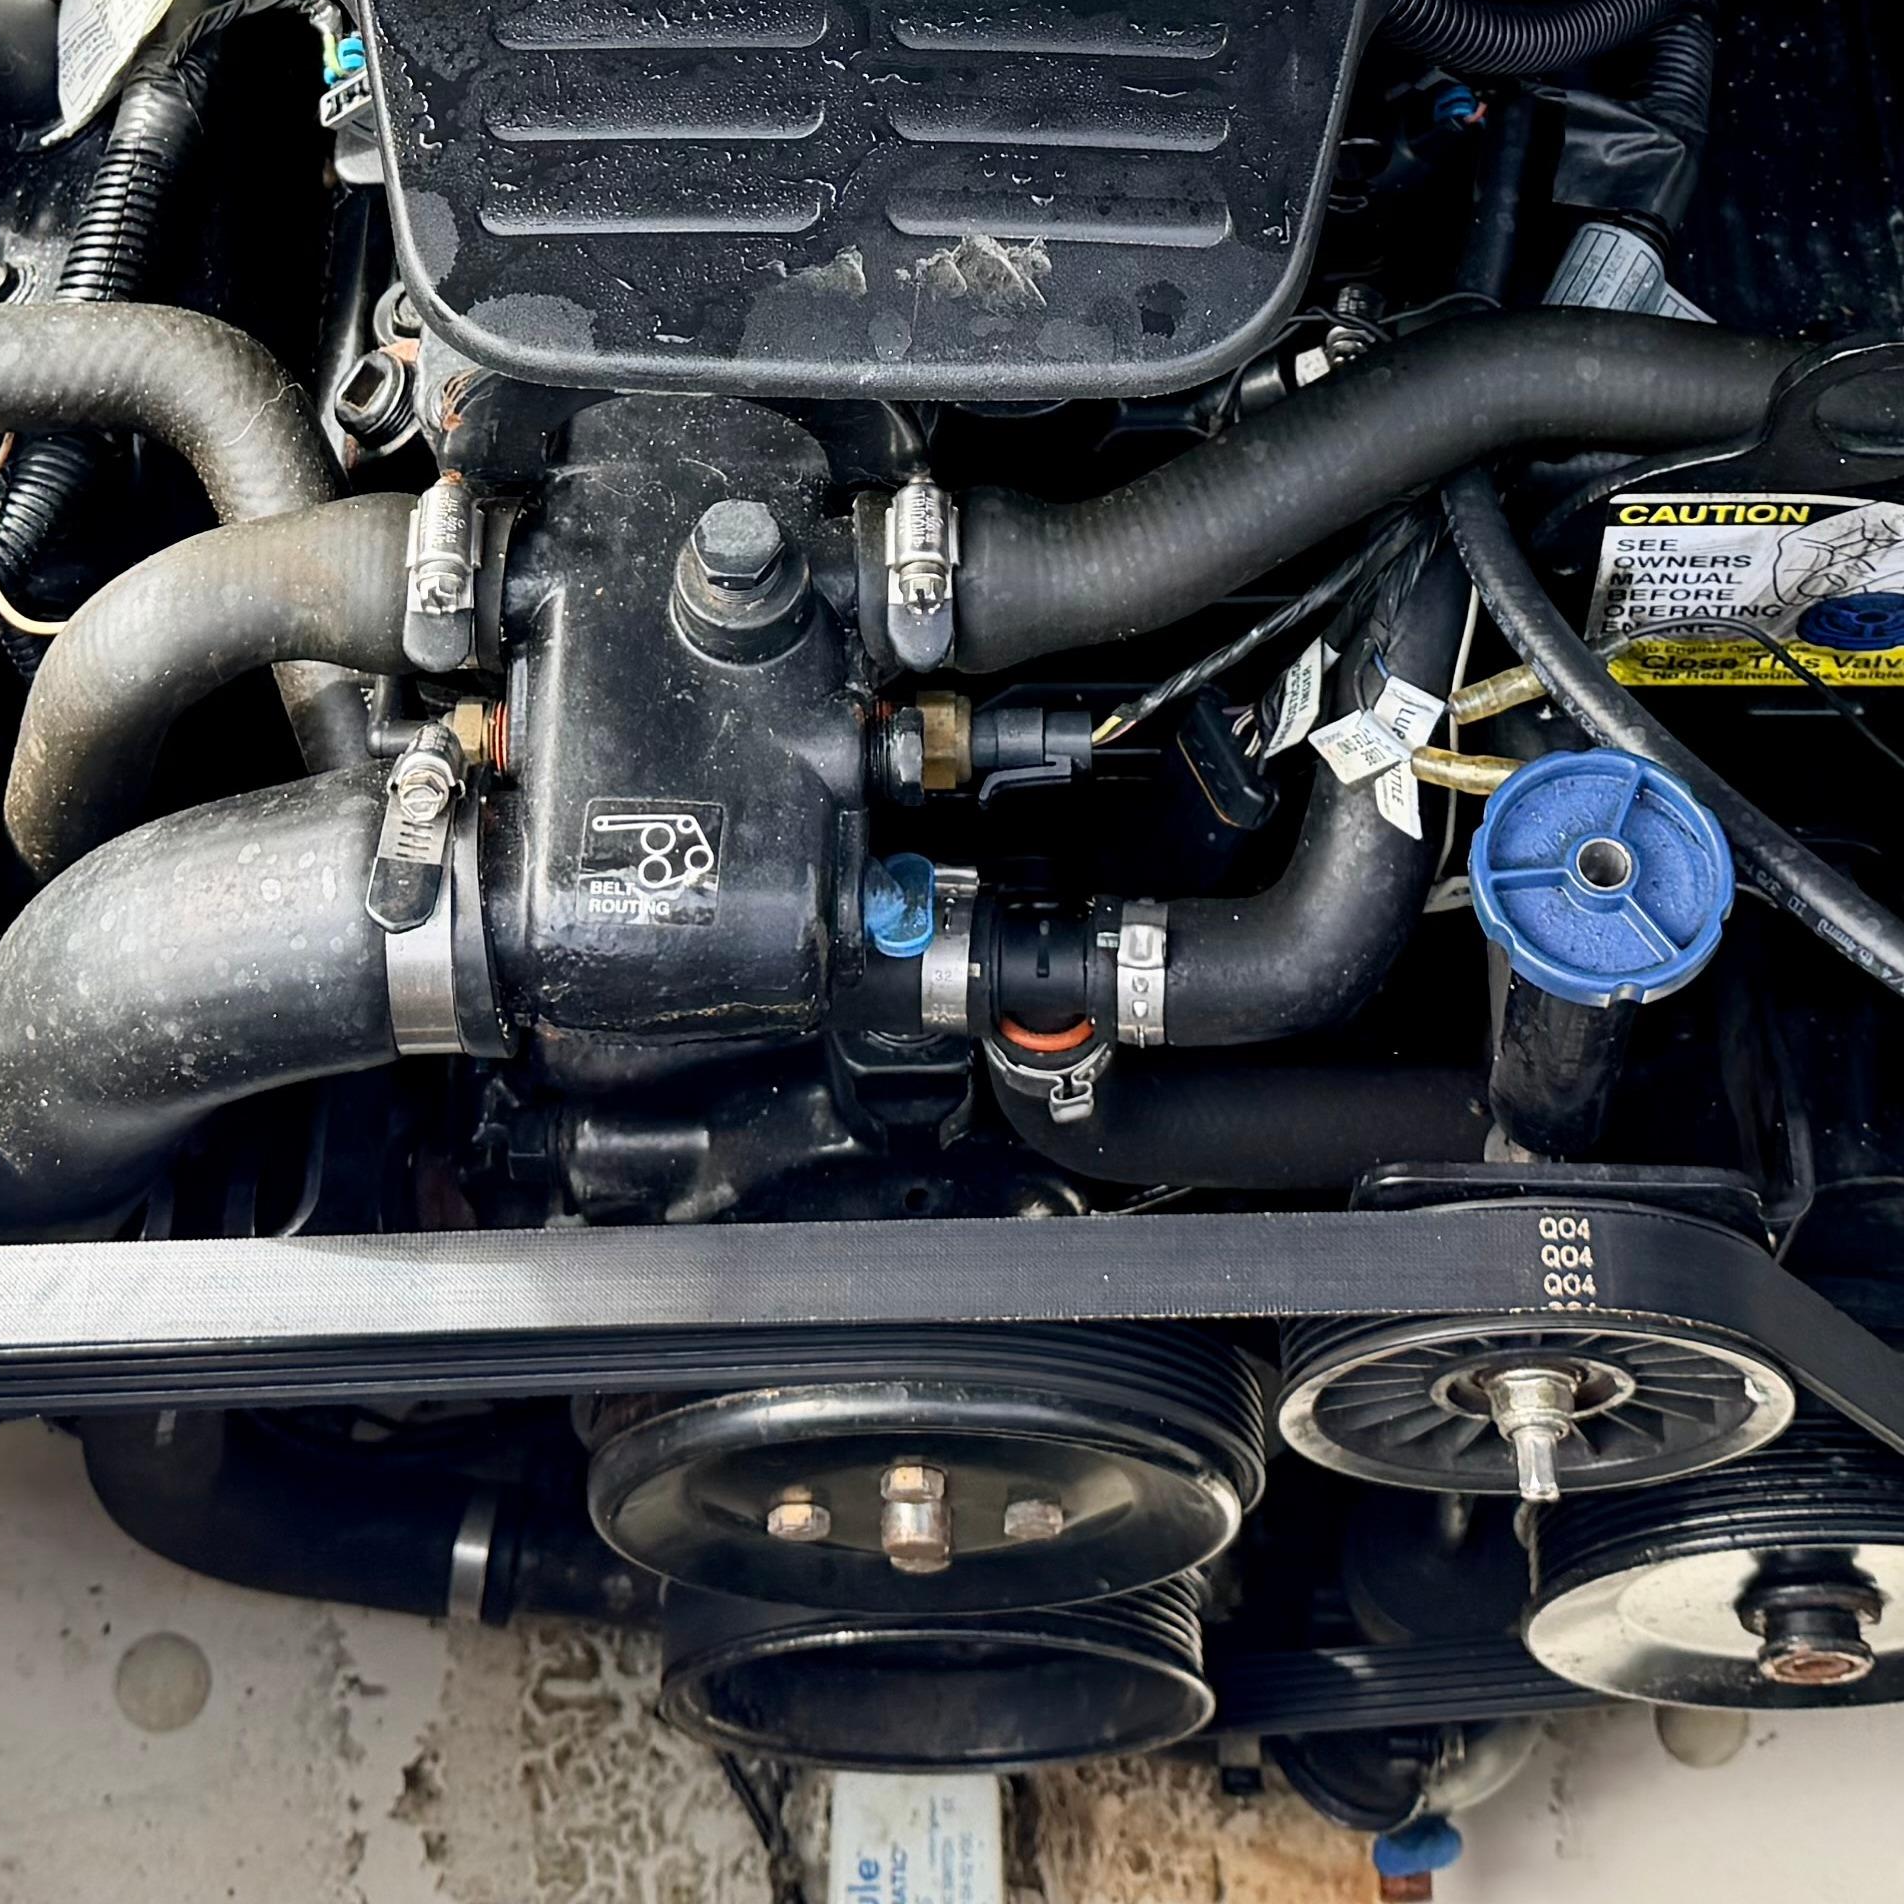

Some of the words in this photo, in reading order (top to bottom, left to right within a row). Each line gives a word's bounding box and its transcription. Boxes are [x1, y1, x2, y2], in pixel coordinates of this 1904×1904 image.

[1619, 505, 1811, 524] CAUTION
[1616, 539, 1679, 551] SEE
[1614, 555, 1752, 568] OWNERS
[1610, 572, 1743, 584] MANUAL
[1607, 589, 1735, 601] BEFORE
[1603, 604, 1784, 618] OPERATING
[1641, 655, 1738, 669] Close
[1839, 670, 1904, 680] Visible
[590, 881, 635, 896] BELT
[1788, 896, 1807, 918] ID
[935, 969, 953, 983] 32
